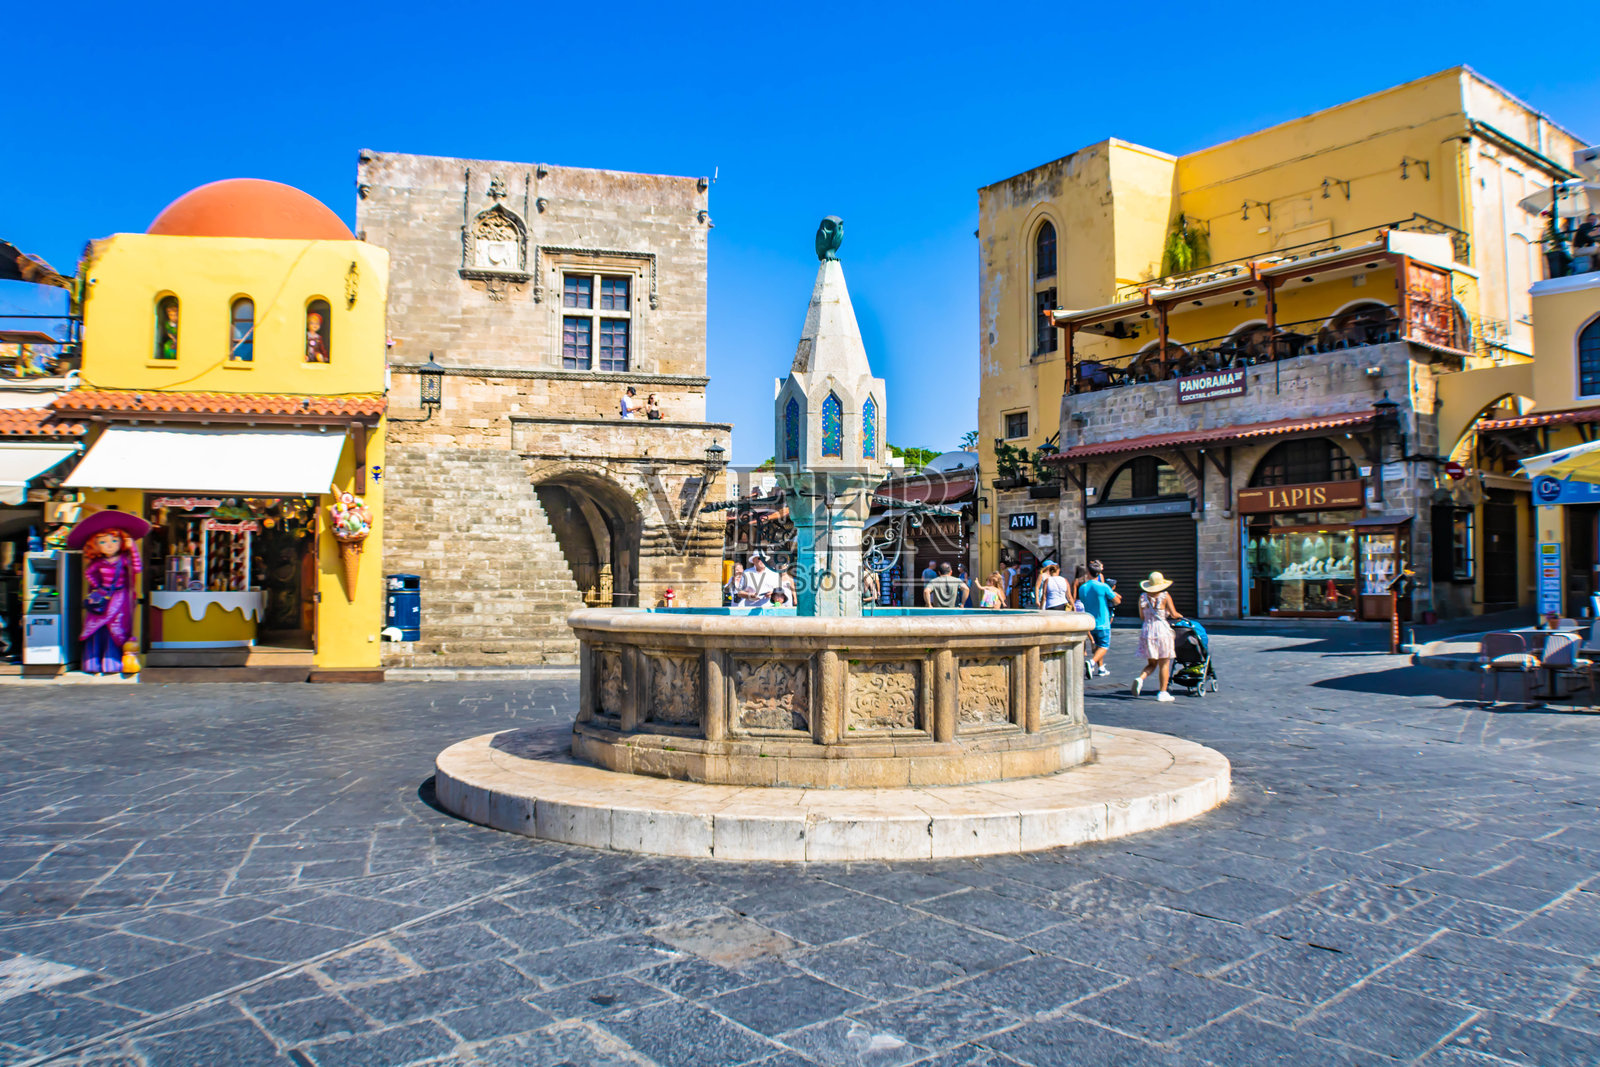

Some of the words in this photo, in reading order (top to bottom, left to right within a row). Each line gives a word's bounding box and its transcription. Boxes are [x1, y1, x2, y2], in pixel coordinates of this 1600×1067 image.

[1180, 373, 1235, 393] PANORAMA
[1269, 487, 1327, 508] LAPIS
[1011, 515, 1034, 527] ATM
